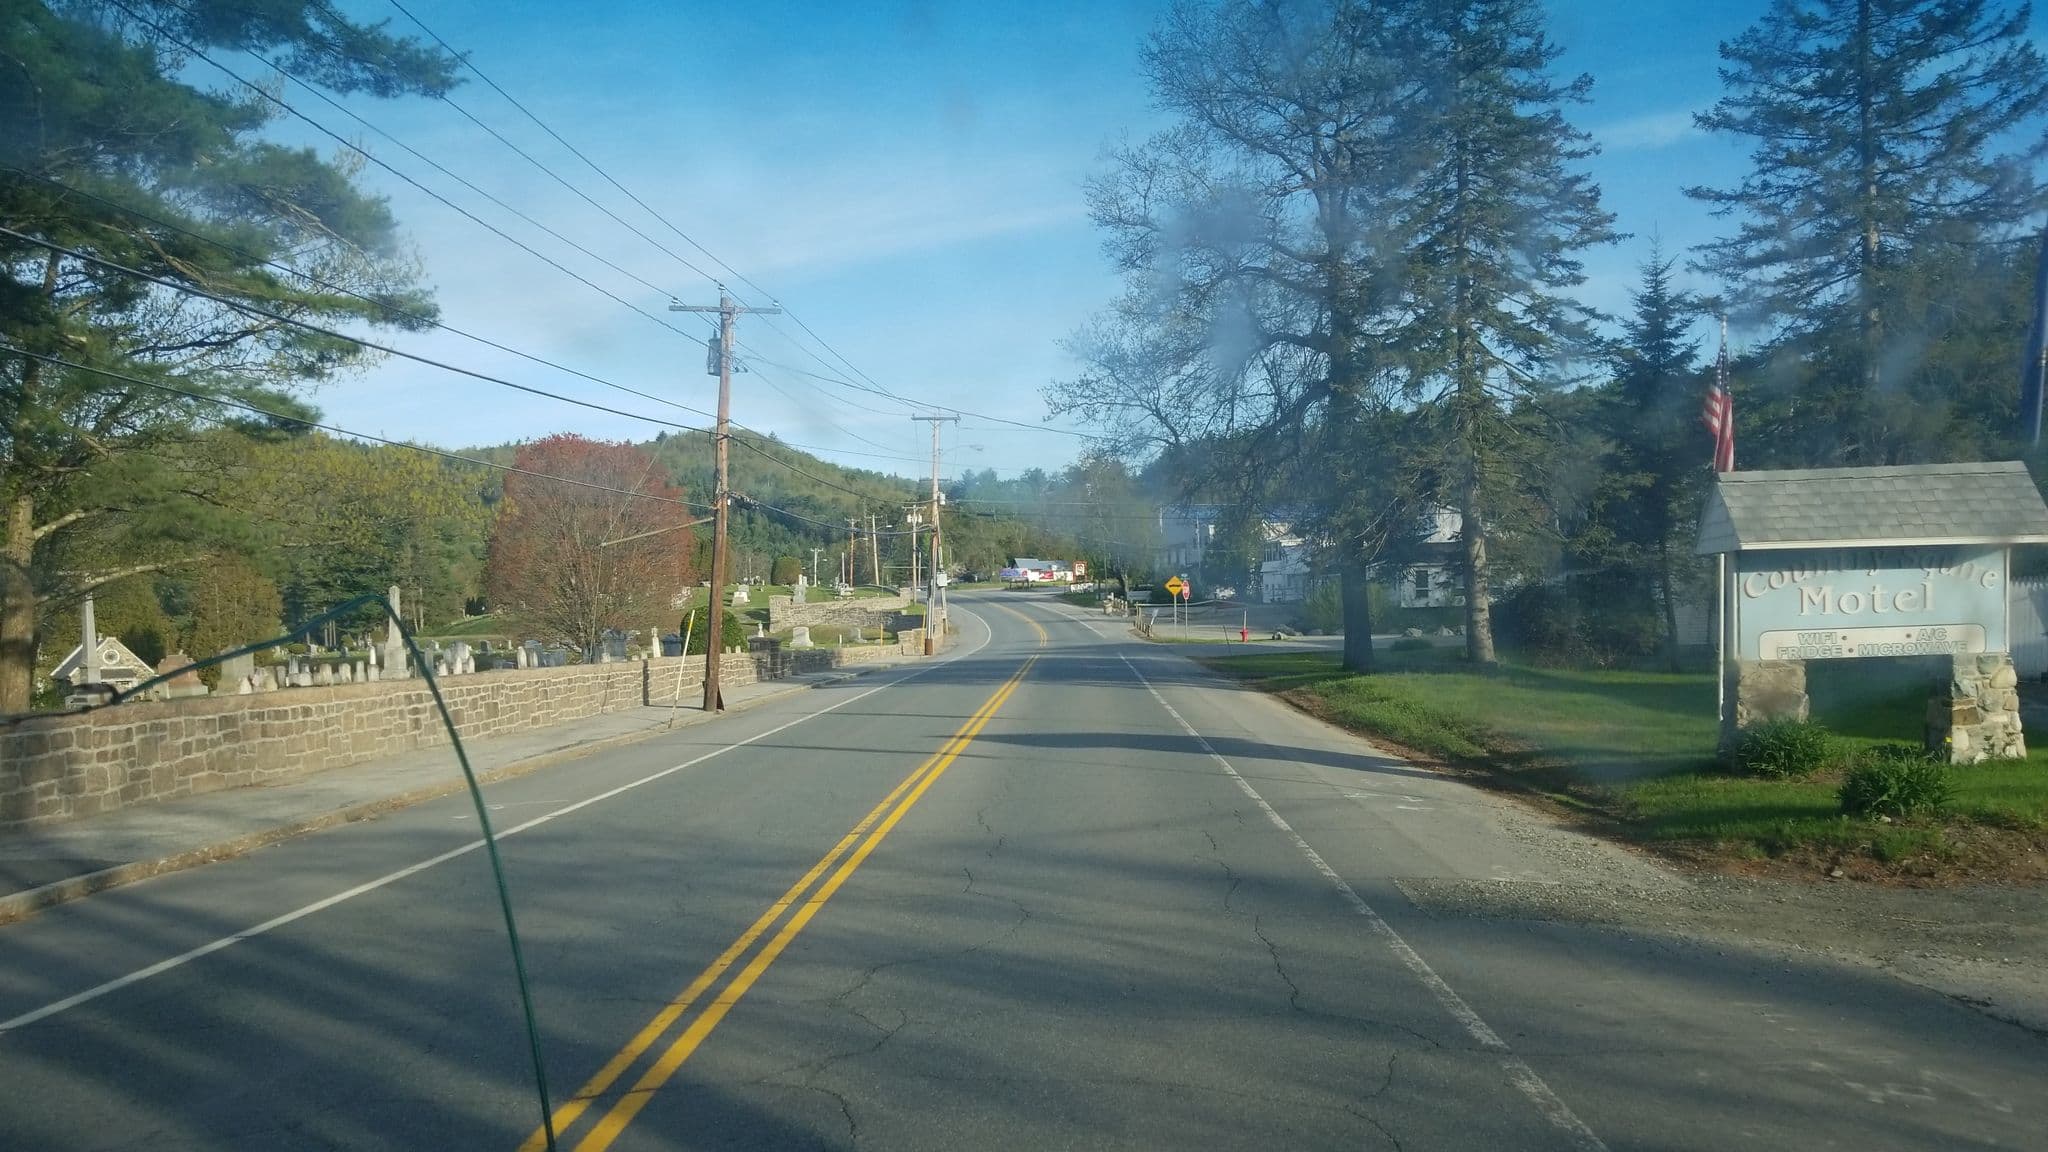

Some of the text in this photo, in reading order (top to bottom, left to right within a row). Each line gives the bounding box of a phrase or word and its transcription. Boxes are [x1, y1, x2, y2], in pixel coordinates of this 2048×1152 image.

[1744, 549, 1888, 598] Country
[1799, 582, 1935, 616] Motel
[1776, 639, 1969, 659] FRIDGE MICROWAVE
[1798, 628, 1949, 645] WIFI A/C
